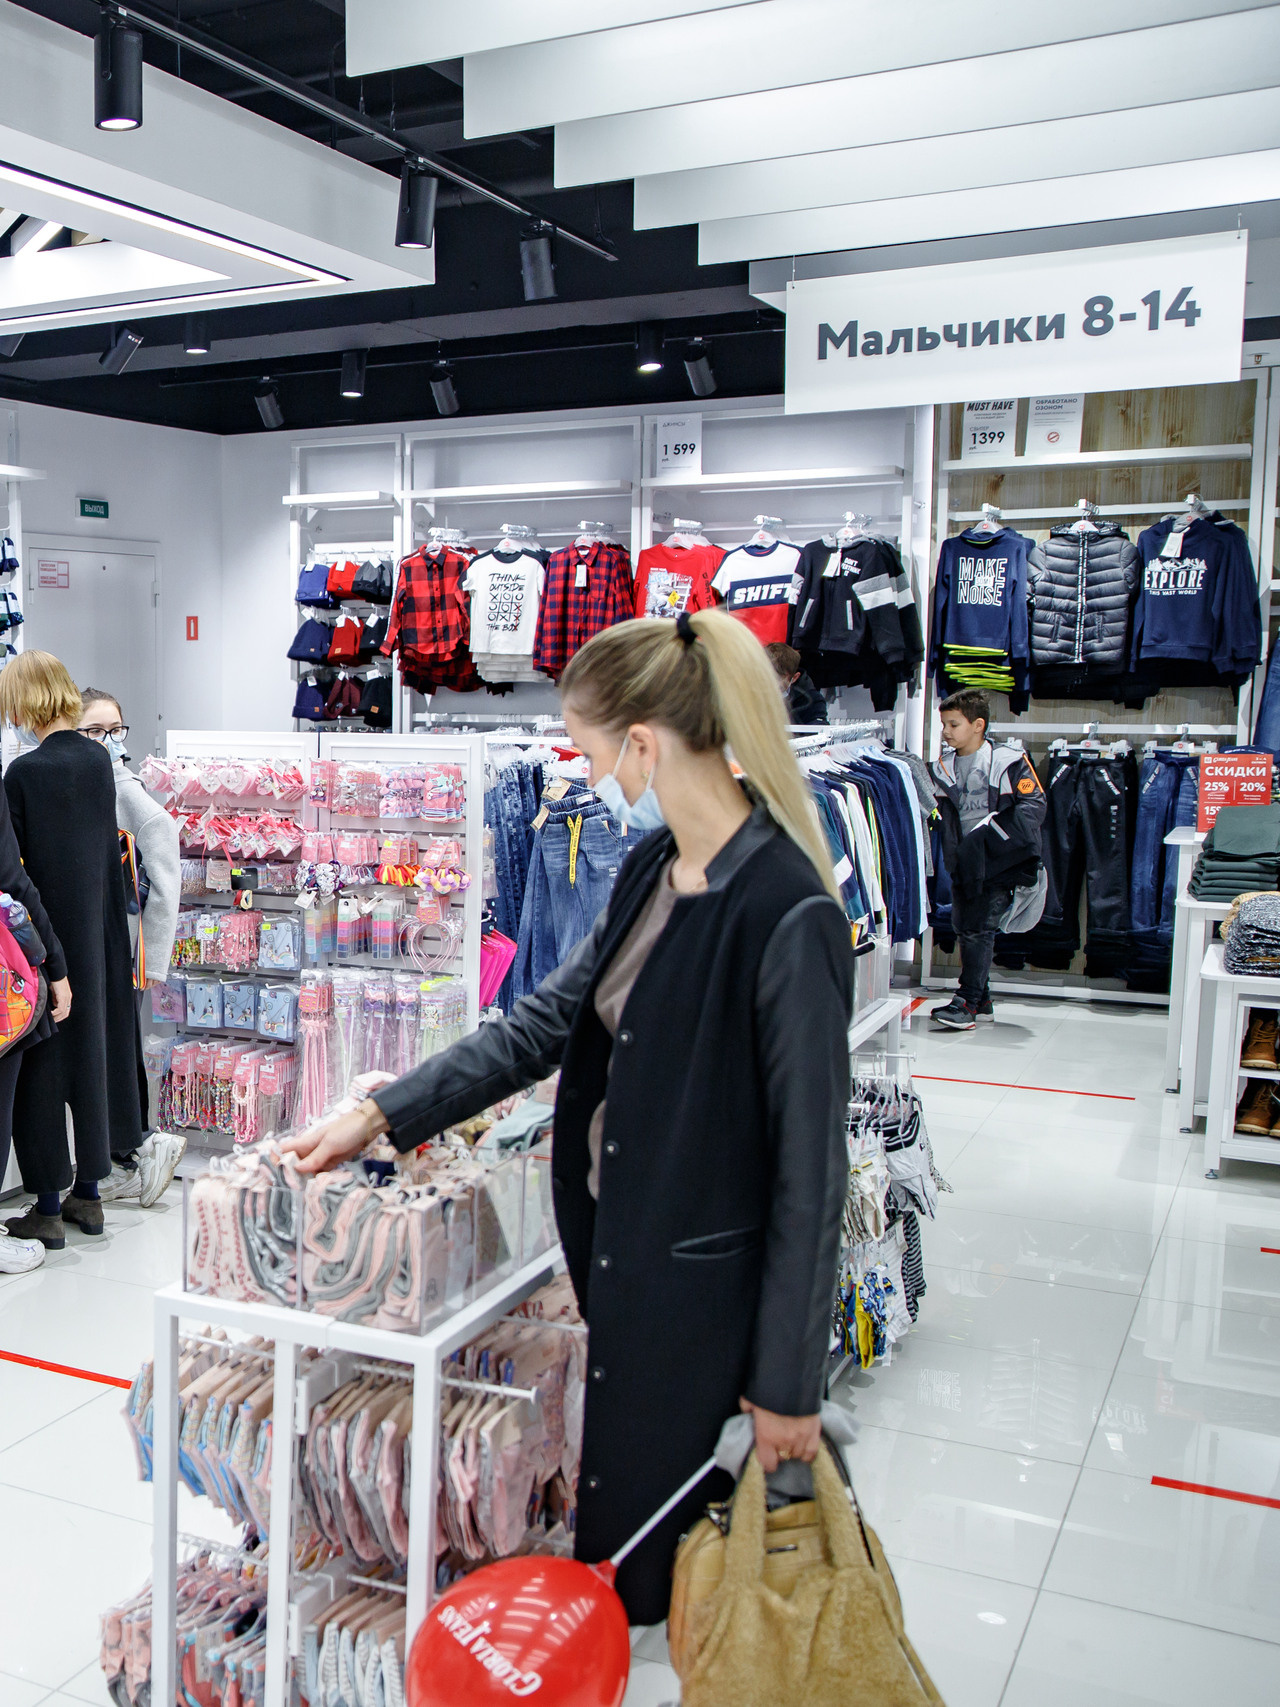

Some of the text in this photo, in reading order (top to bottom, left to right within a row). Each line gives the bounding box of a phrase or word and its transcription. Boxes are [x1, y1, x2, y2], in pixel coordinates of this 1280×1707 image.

[818, 286, 1201, 360] Мальчики 8-14
[967, 401, 1015, 411] MUST HAVE
[971, 431, 1005, 445] 1399
[663, 443, 696, 455] 1 599
[85, 504, 105, 515] ВЫХОД
[958, 557, 1008, 582] MAKE
[488, 572, 526, 582] THINK
[1144, 569, 1206, 588] EXPLORE
[489, 583, 525, 592] OUTSIDE
[733, 582, 792, 605] SHIFT
[958, 581, 1005, 607] NOISE
[487, 622, 520, 632] THE BOX
[1204, 766, 1267, 777] СКИДКИ
[1204, 781, 1266, 792] 25% 20%
[436, 1605, 543, 1696] GLORIA JEANS
